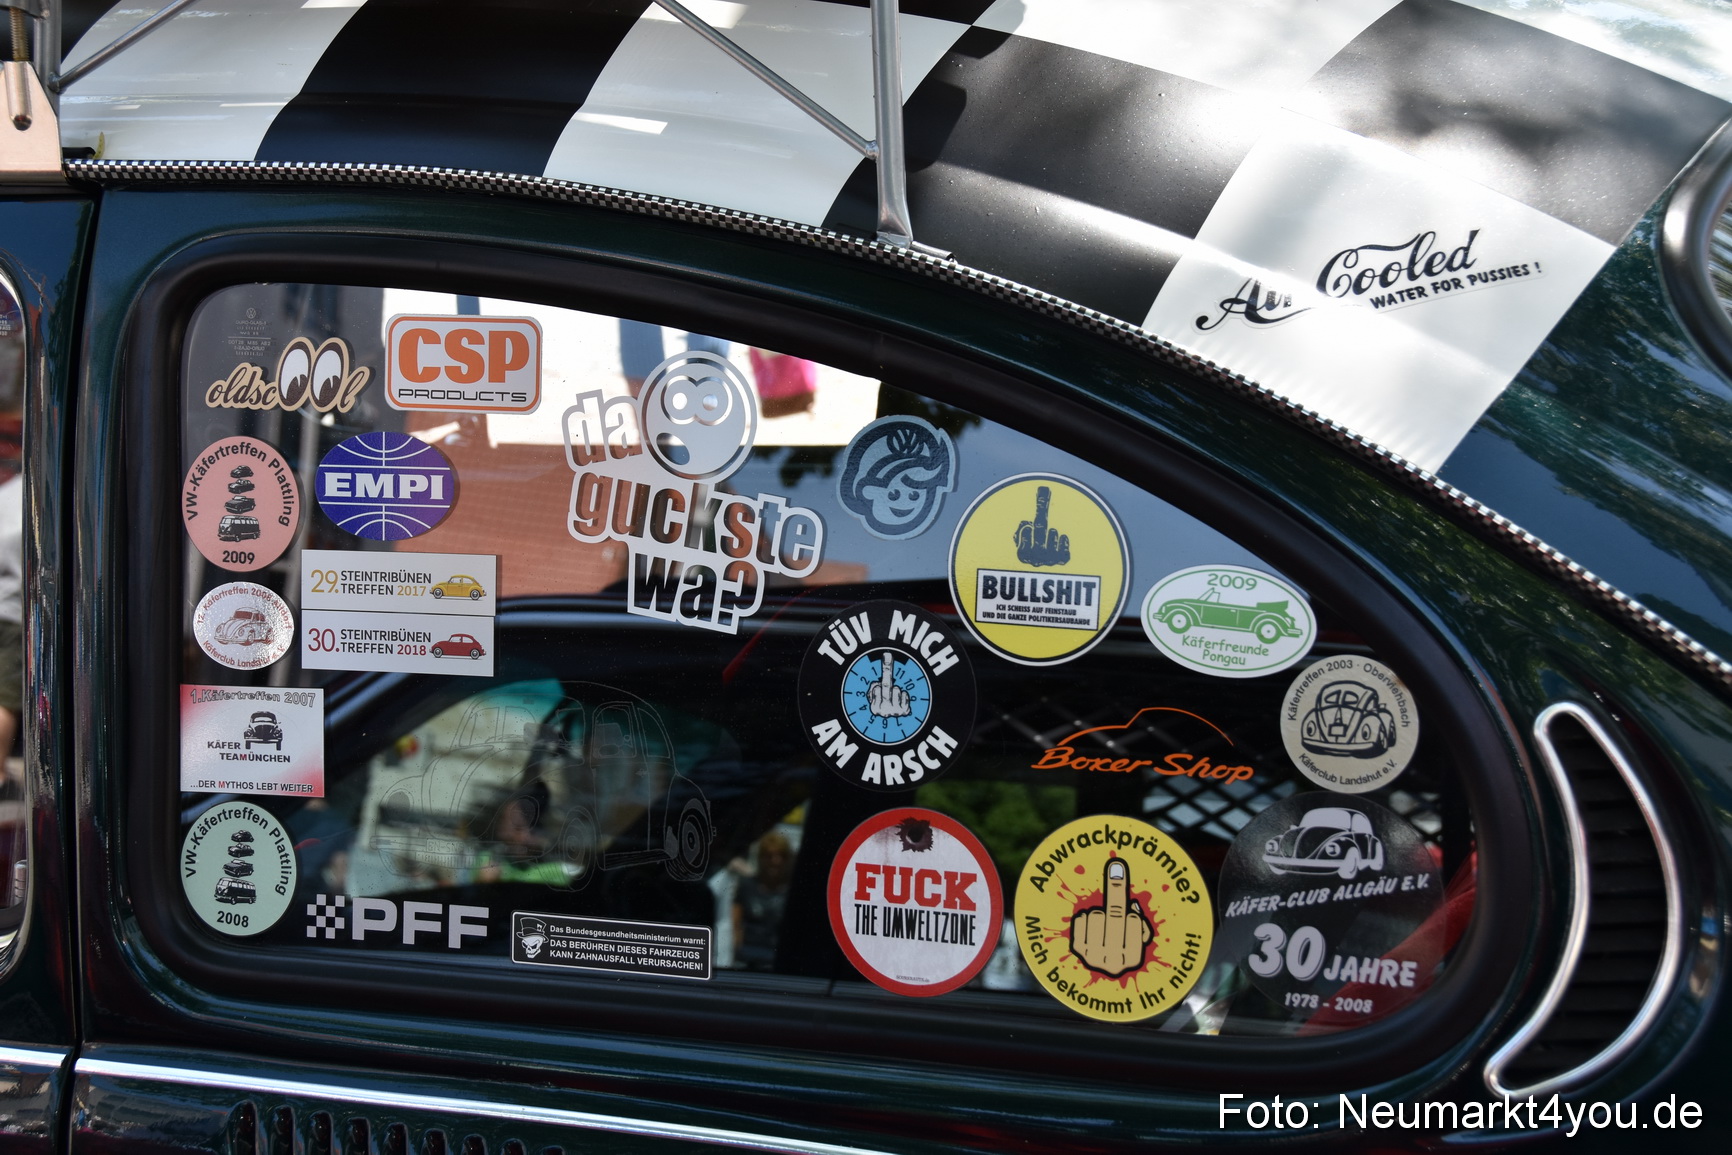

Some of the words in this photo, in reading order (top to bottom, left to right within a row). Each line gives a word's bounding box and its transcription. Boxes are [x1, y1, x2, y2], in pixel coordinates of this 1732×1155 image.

[1315, 228, 1481, 299] Cooled
[1369, 285, 1429, 310] WATER
[1431, 277, 1465, 295] FOR
[1469, 263, 1531, 287] PUSSIES
[398, 327, 530, 385] CSP
[398, 388, 527, 403] PRODUCTS
[563, 389, 643, 467] da
[185, 442, 268, 522] VW-Käfertreffen
[268, 456, 295, 528] Plattling
[323, 471, 445, 500] EMPI
[573, 470, 819, 573] guckste
[222, 550, 256, 565] 2009
[310, 569, 340, 594] 29.
[340, 569, 432, 584] STEINTRIBÜNEN
[340, 582, 395, 596] TREFFEN
[397, 585, 427, 597] 2017
[632, 552, 760, 630] wa?
[981, 574, 1097, 607] BULLSHIT
[1206, 572, 1259, 592] 2009
[982, 611, 995, 619] UND
[996, 612, 1007, 620] DIE
[1007, 613, 1027, 621] GANZE
[1007, 605, 1031, 613] SCHEISS
[1031, 606, 1044, 614] AUF
[1044, 608, 1077, 616] FEINSTAUB
[203, 640, 236, 666] Käferclub
[307, 627, 340, 653] 30.
[340, 628, 432, 643] STEINTRIBÜNEN
[340, 641, 394, 655] TREFFEN
[396, 644, 427, 656] 2018
[816, 610, 874, 666] TÜV
[887, 609, 960, 676] MICH
[1181, 634, 1270, 657] Käferfreunde
[1201, 649, 1247, 668] Pongau
[284, 690, 316, 709] 2007
[1287, 666, 1326, 721] Käfertreffen
[1325, 659, 1354, 672] 2003
[1362, 662, 1411, 728] Oberviehbach
[207, 739, 242, 751] KÄFER
[219, 750, 291, 763] TEAMÜNCHEN
[811, 718, 860, 770] AM
[860, 725, 959, 786] ARSCH
[1031, 745, 1153, 773] Boxer
[1153, 752, 1255, 785] Shop
[1298, 752, 1338, 783] Käferclub
[1339, 769, 1382, 786] Landshut
[1381, 758, 1398, 775] e.V.
[218, 780, 254, 791] MYTHOS
[256, 781, 279, 791] LEBT
[279, 782, 314, 794] WEITER
[183, 807, 270, 879] VW-Käfertreffen
[266, 824, 295, 897] Plattling
[1028, 822, 1202, 906] Abwrackprämie?
[854, 862, 978, 912] FUCK
[1225, 886, 1331, 918] KÄFER-CLUB
[1332, 876, 1398, 902] ALLGÄU
[1400, 873, 1431, 891] E.V.
[216, 909, 250, 929] 2008
[351, 898, 490, 949] PFF
[854, 903, 878, 937] THE
[881, 906, 977, 947] UMWELTZONE
[549, 924, 564, 934] Das
[565, 926, 682, 944] Bundesgesundheitsministerium
[682, 935, 706, 946] warnt:
[549, 938, 568, 949] DAS
[569, 940, 615, 953] BERÜHREN
[617, 945, 648, 955] DIESES
[649, 947, 701, 960] FAHRZEUGS
[549, 949, 574, 959] KANN
[574, 951, 636, 965] ZAHNAUSFALL
[637, 957, 704, 971] VERURSACHEN!
[1025, 915, 1048, 965] Mich
[1046, 963, 1134, 1015] bekommt
[1139, 988, 1167, 1011] Ihr
[1172, 931, 1203, 990] nicht!
[1248, 922, 1326, 982] 30
[1323, 954, 1419, 988] JAHRE
[1283, 991, 1320, 1009] 1978
[1334, 995, 1374, 1014] 2008
